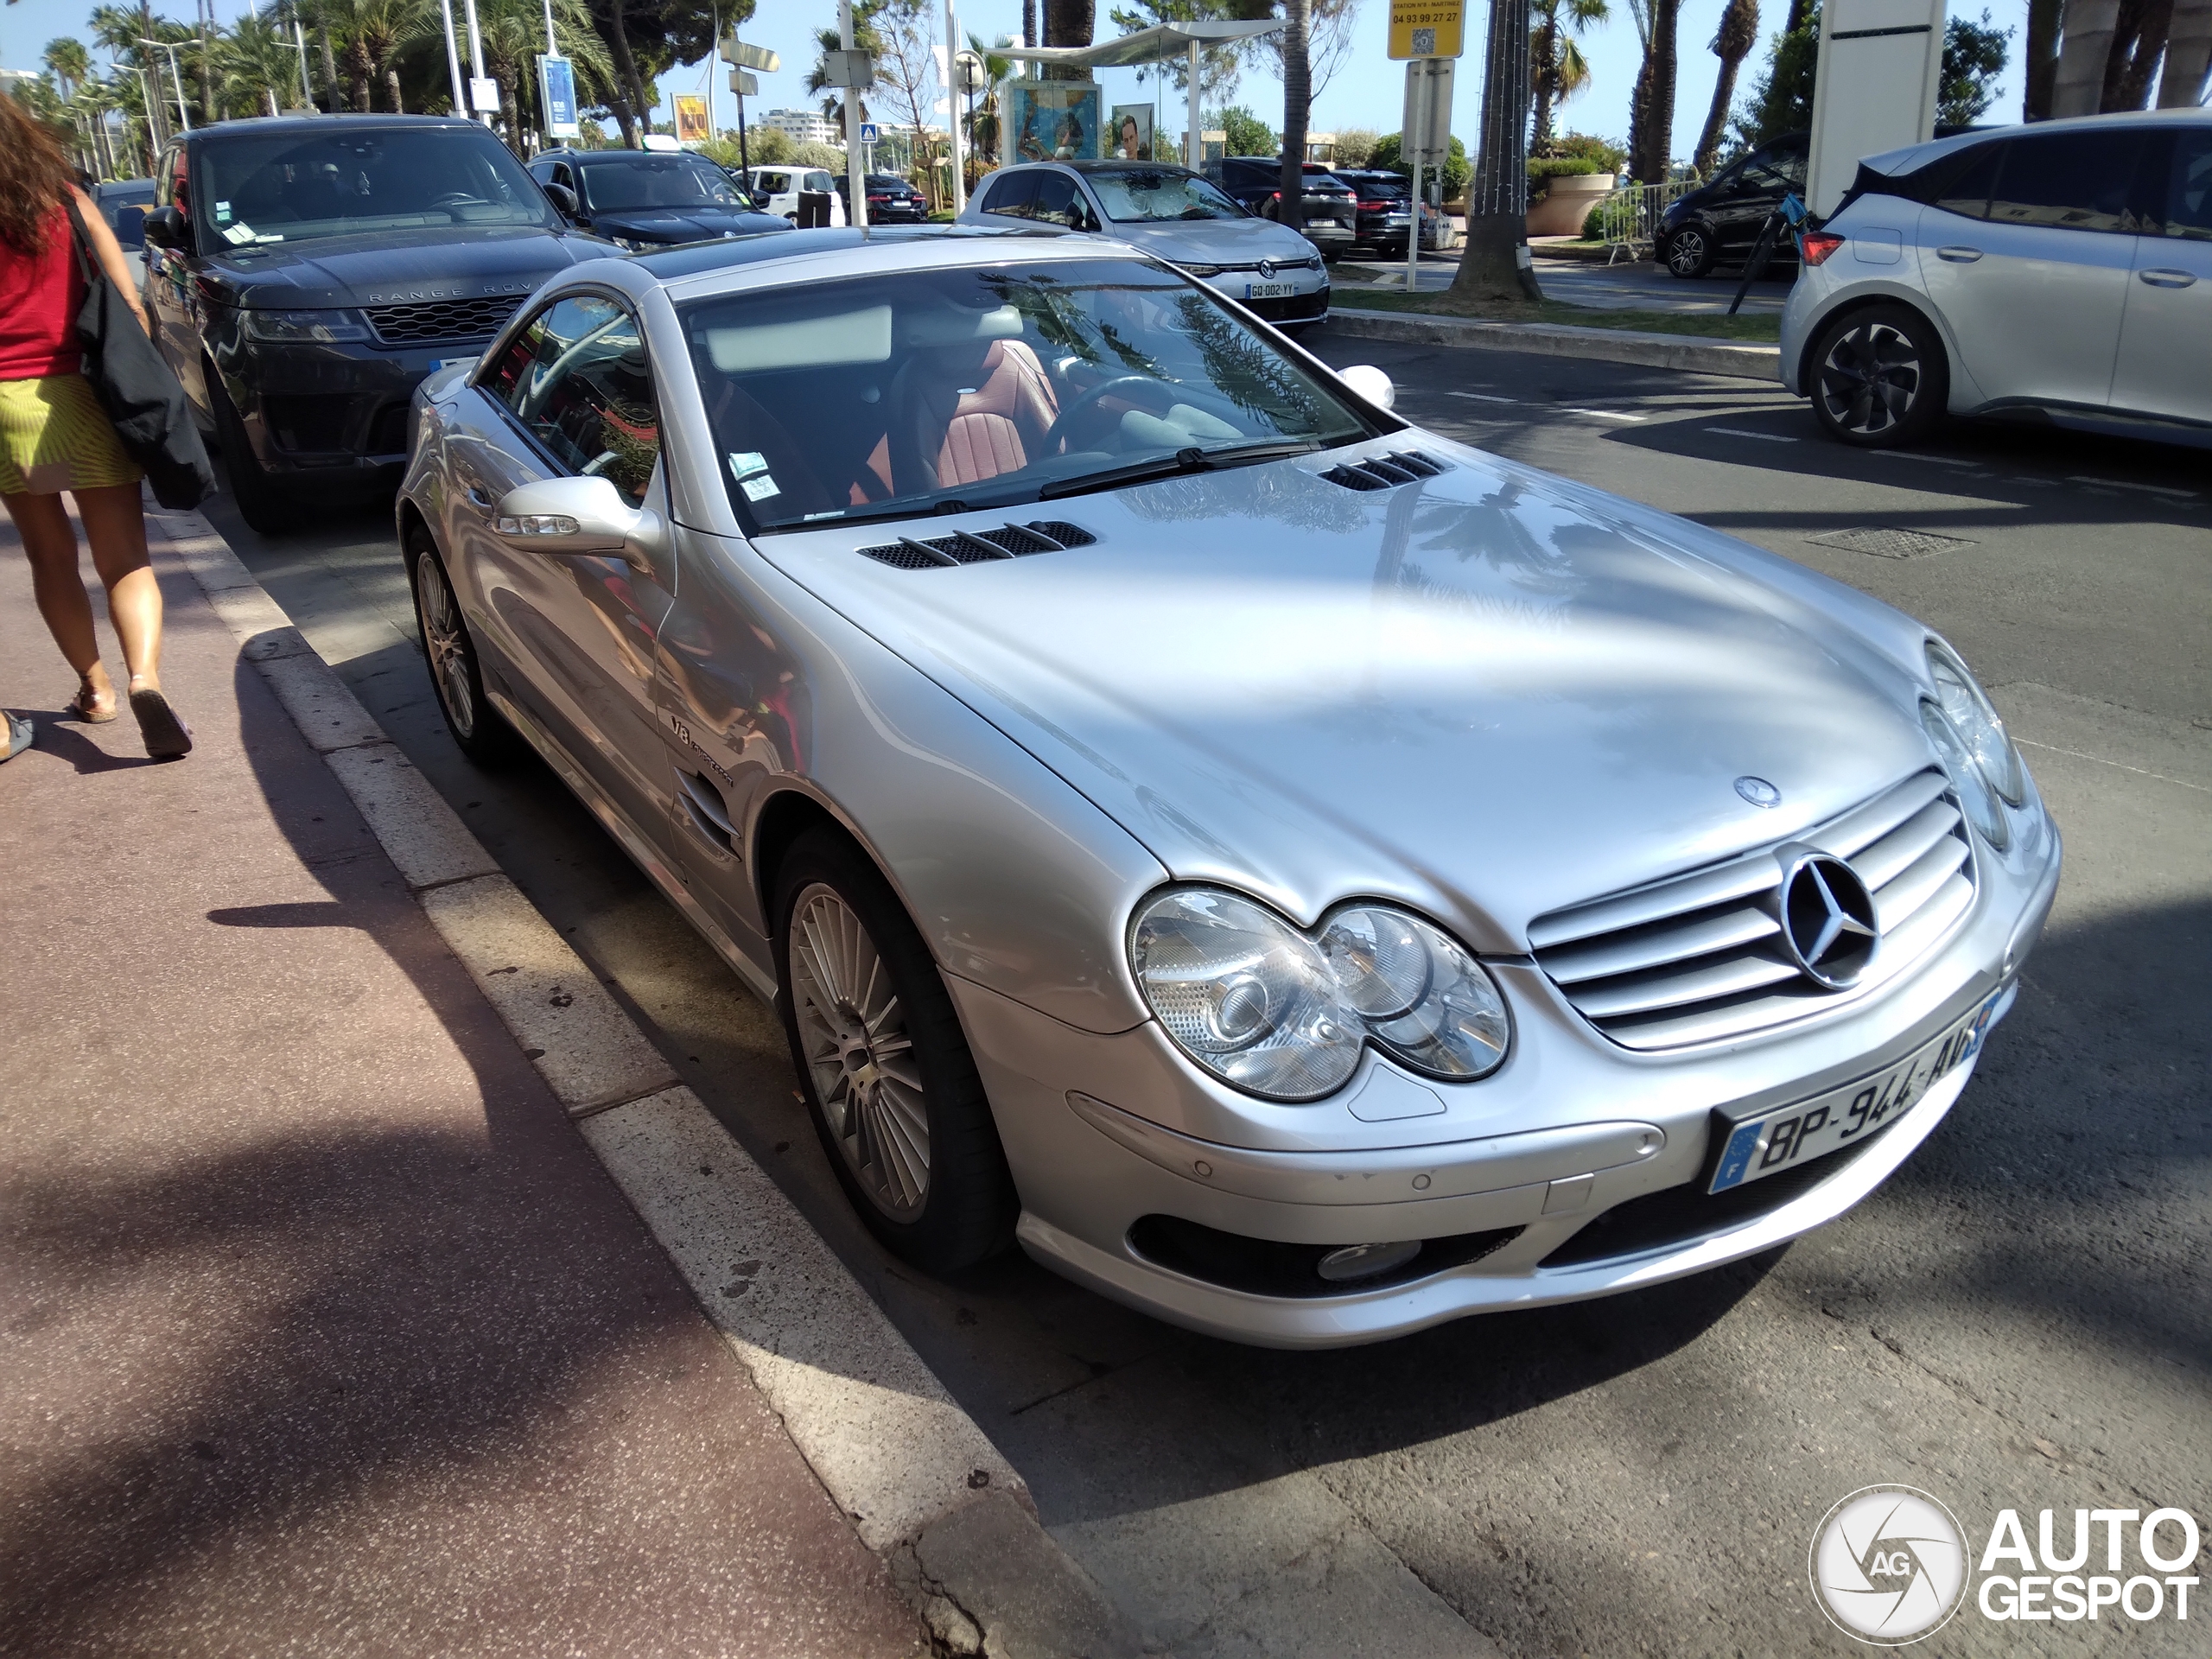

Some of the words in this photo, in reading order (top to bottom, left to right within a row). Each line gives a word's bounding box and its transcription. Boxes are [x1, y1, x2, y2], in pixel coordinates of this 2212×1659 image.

[1393, 15, 1404, 24] 04
[1406, 14, 1417, 23] 93
[1420, 14, 1431, 22] 99
[1433, 13, 1444, 22] 27
[1446, 12, 1458, 22] 27
[368, 288, 464, 303] RANGE
[483, 281, 544, 295] ROV
[1252, 283, 1293, 296] GQ-002-YY
[671, 715, 690, 745] V8
